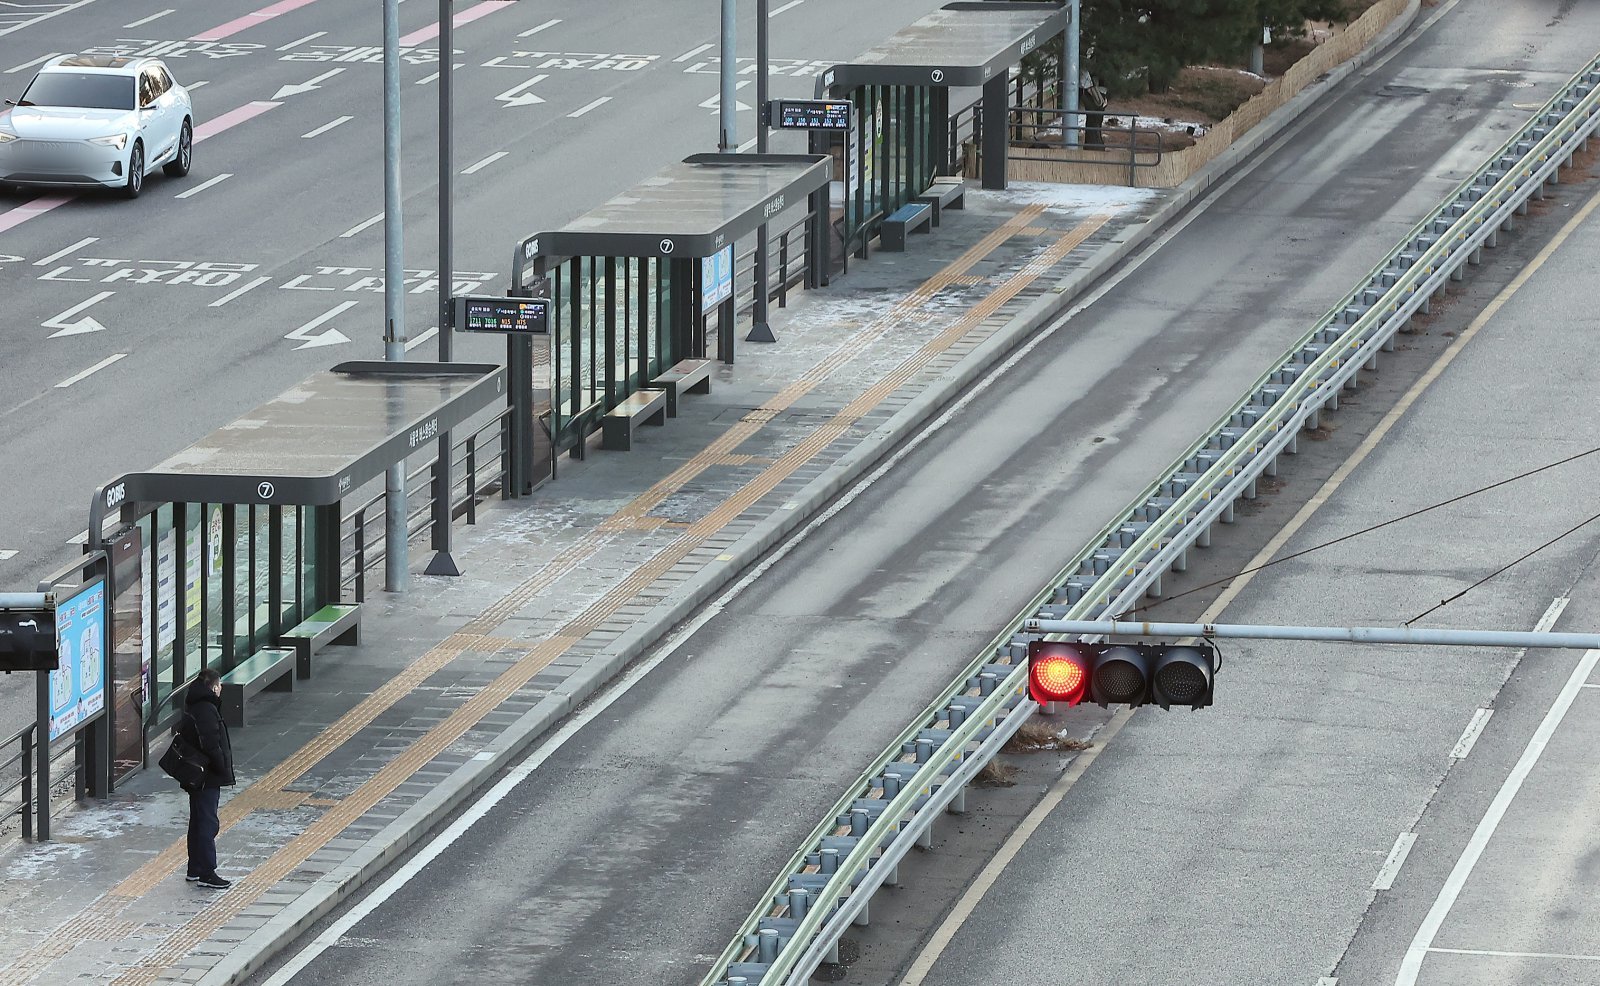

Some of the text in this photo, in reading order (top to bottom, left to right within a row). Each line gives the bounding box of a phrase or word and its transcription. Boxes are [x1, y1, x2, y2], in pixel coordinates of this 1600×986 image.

[480, 51, 661, 71] 염천교
[37, 257, 259, 287] 염천교
[279, 265, 498, 294] 염천교
